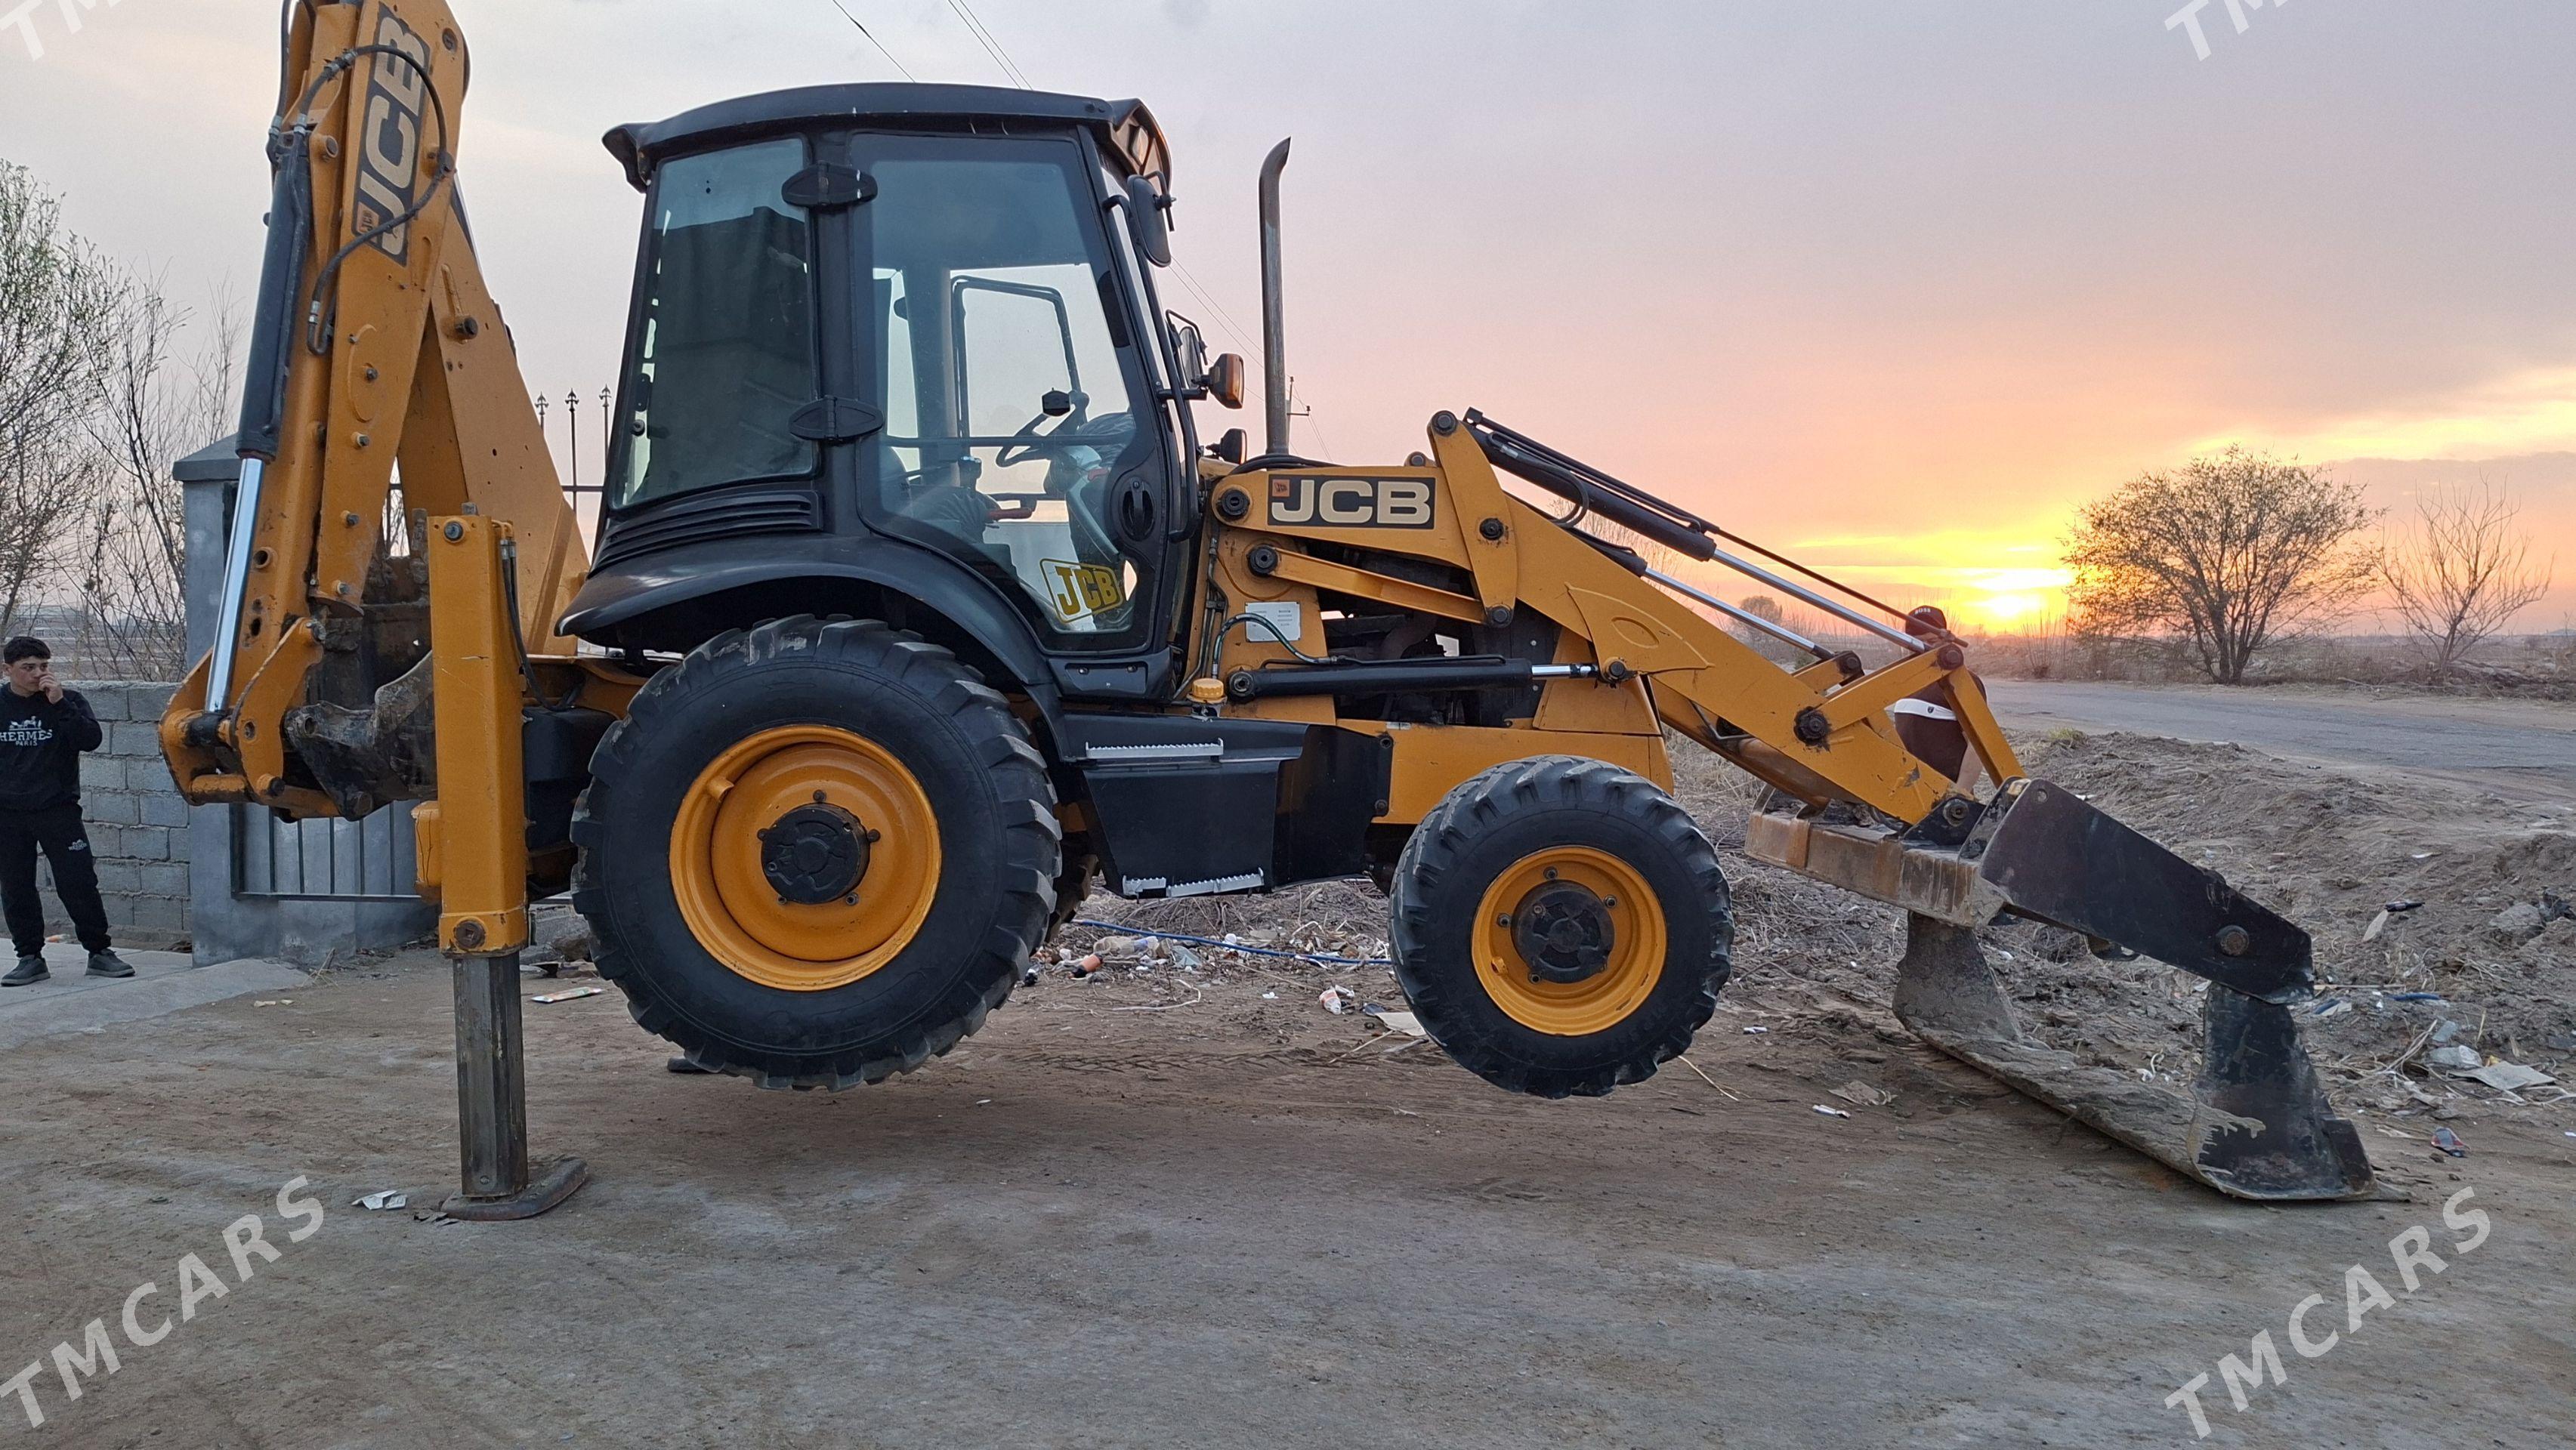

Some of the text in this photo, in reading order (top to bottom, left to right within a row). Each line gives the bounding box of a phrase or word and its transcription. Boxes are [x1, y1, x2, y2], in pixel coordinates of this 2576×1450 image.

[360, 17, 425, 255] JCB
[1271, 480, 1431, 525] JCB
[1055, 566, 1118, 615] JCB
